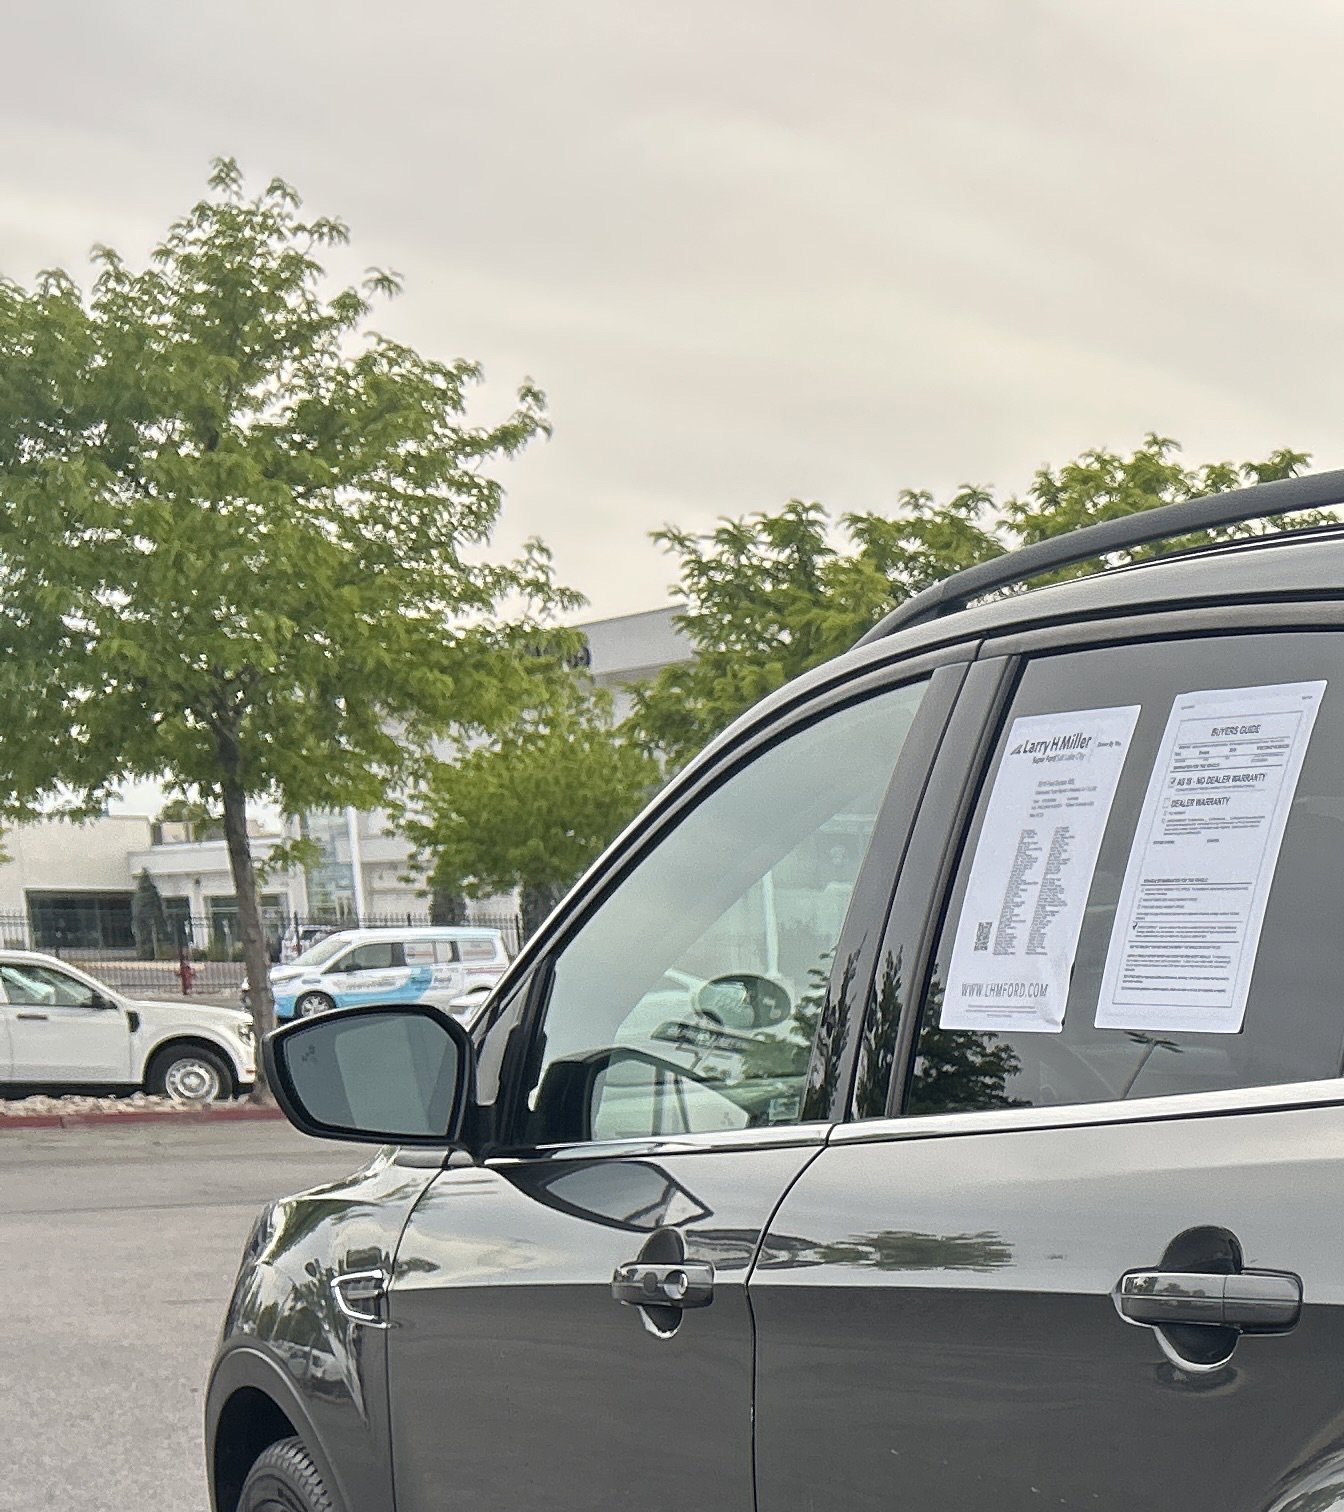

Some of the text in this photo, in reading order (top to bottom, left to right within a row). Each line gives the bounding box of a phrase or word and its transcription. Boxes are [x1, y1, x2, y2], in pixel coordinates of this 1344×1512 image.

[1022, 739, 1051, 755] Larry
[1050, 736, 1060, 751] H
[1059, 732, 1092, 750] Miller
